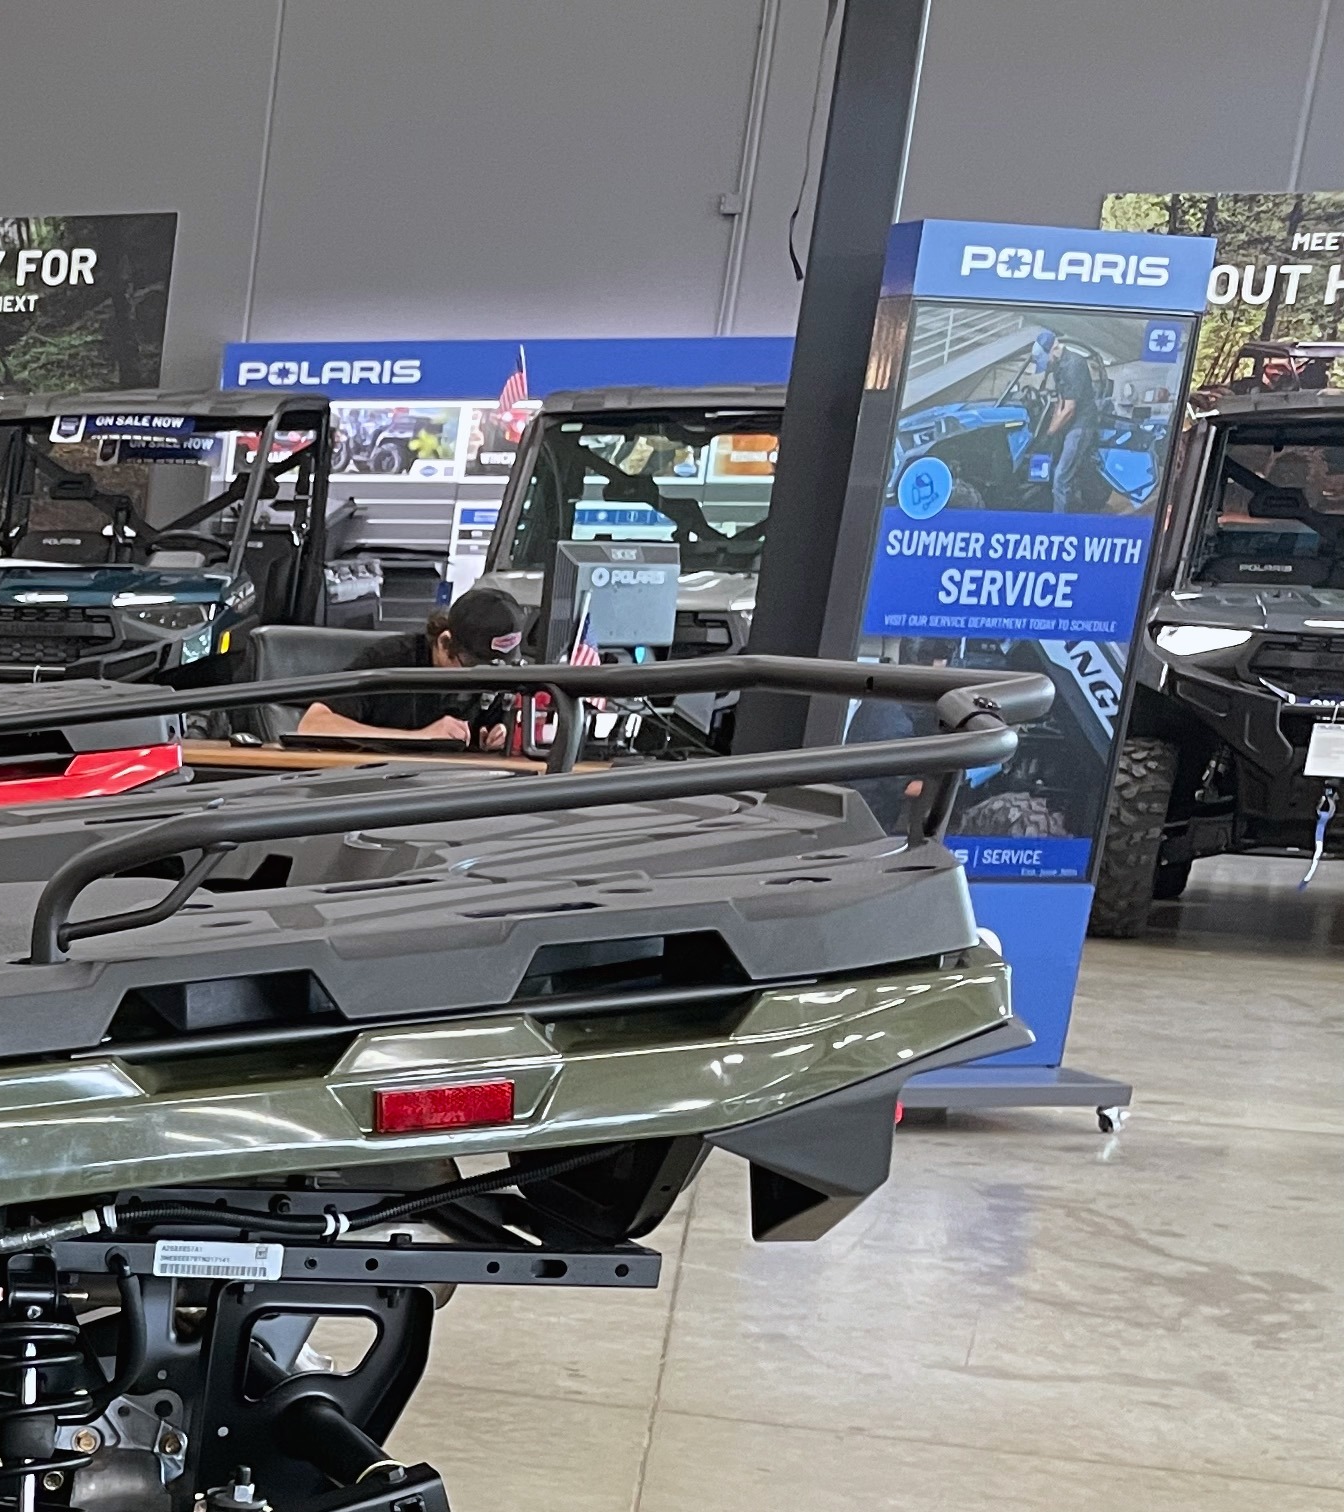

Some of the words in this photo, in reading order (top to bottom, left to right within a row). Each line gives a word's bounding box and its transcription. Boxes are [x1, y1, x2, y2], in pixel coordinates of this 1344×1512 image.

[16, 248, 98, 287] FOR
[960, 245, 1171, 287] POLARIS
[238, 359, 423, 386] POLARIS
[96, 415, 113, 427] ON
[115, 415, 151, 428] SALE
[152, 416, 185, 429] NOW
[886, 530, 982, 558] SUMMER
[989, 533, 1078, 561] STARTS
[1084, 537, 1142, 564] WITH
[1239, 563, 1293, 572] POLARIS
[938, 569, 1078, 608] SERVICE
[884, 614, 906, 626] VISIT
[908, 615, 927, 627] OUR
[929, 615, 966, 628] SERVICE
[968, 616, 1026, 630] DEPARTMENT
[1070, 620, 1117, 632] SCHEDULE
[982, 849, 1042, 865] SERVICE
